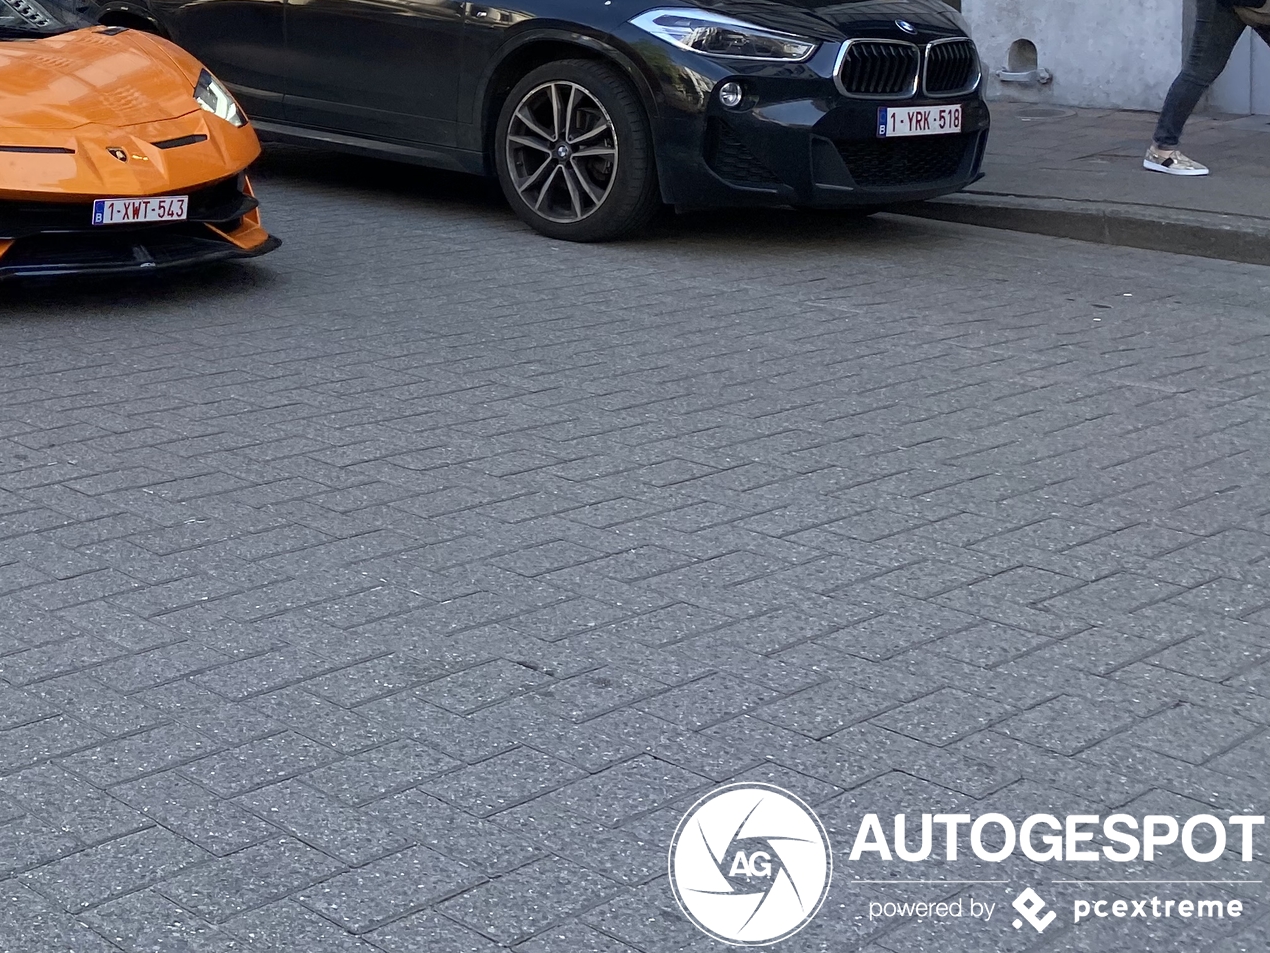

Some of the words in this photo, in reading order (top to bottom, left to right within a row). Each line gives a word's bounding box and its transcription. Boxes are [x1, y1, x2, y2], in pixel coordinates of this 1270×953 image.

[879, 125, 886, 134] B
[95, 213, 103, 223] B
[108, 199, 185, 222] 1-XWT-543
